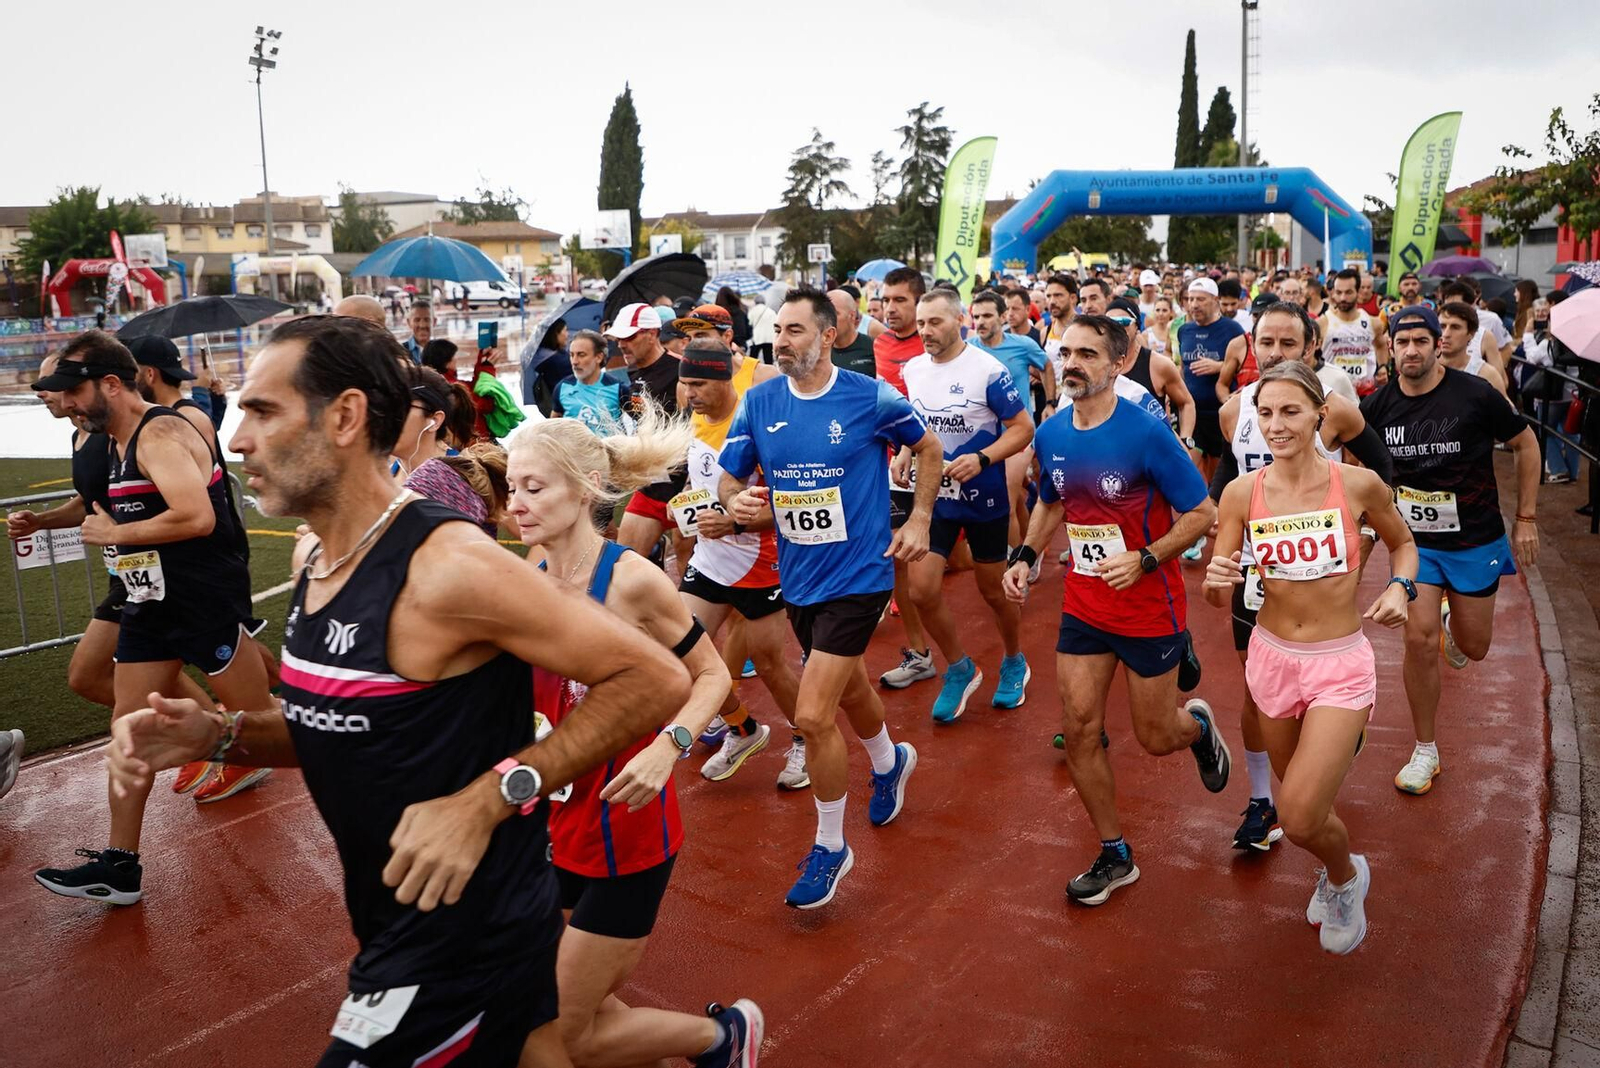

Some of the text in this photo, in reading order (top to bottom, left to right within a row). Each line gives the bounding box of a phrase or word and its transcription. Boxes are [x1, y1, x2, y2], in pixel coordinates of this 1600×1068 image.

[1089, 171, 1279, 191] Ayuntamiento de Santa Fe
[1412, 143, 1436, 236] Diputación
[956, 163, 975, 246] Diputación
[928, 415, 965, 427] NEVADA
[940, 425, 974, 434] RUNNING
[1385, 425, 1405, 446] XVI
[1418, 443, 1430, 456] DE
[1430, 441, 1461, 454] FONDO
[773, 467, 845, 479] PAZITO a PAZITO
[789, 496, 825, 505] FONDO
[784, 509, 833, 531] 168
[1410, 504, 1439, 522] 59
[1274, 519, 1321, 534] FONDO
[36, 543, 47, 552] de
[1081, 543, 1107, 563] 43
[1256, 533, 1338, 566] 2001
